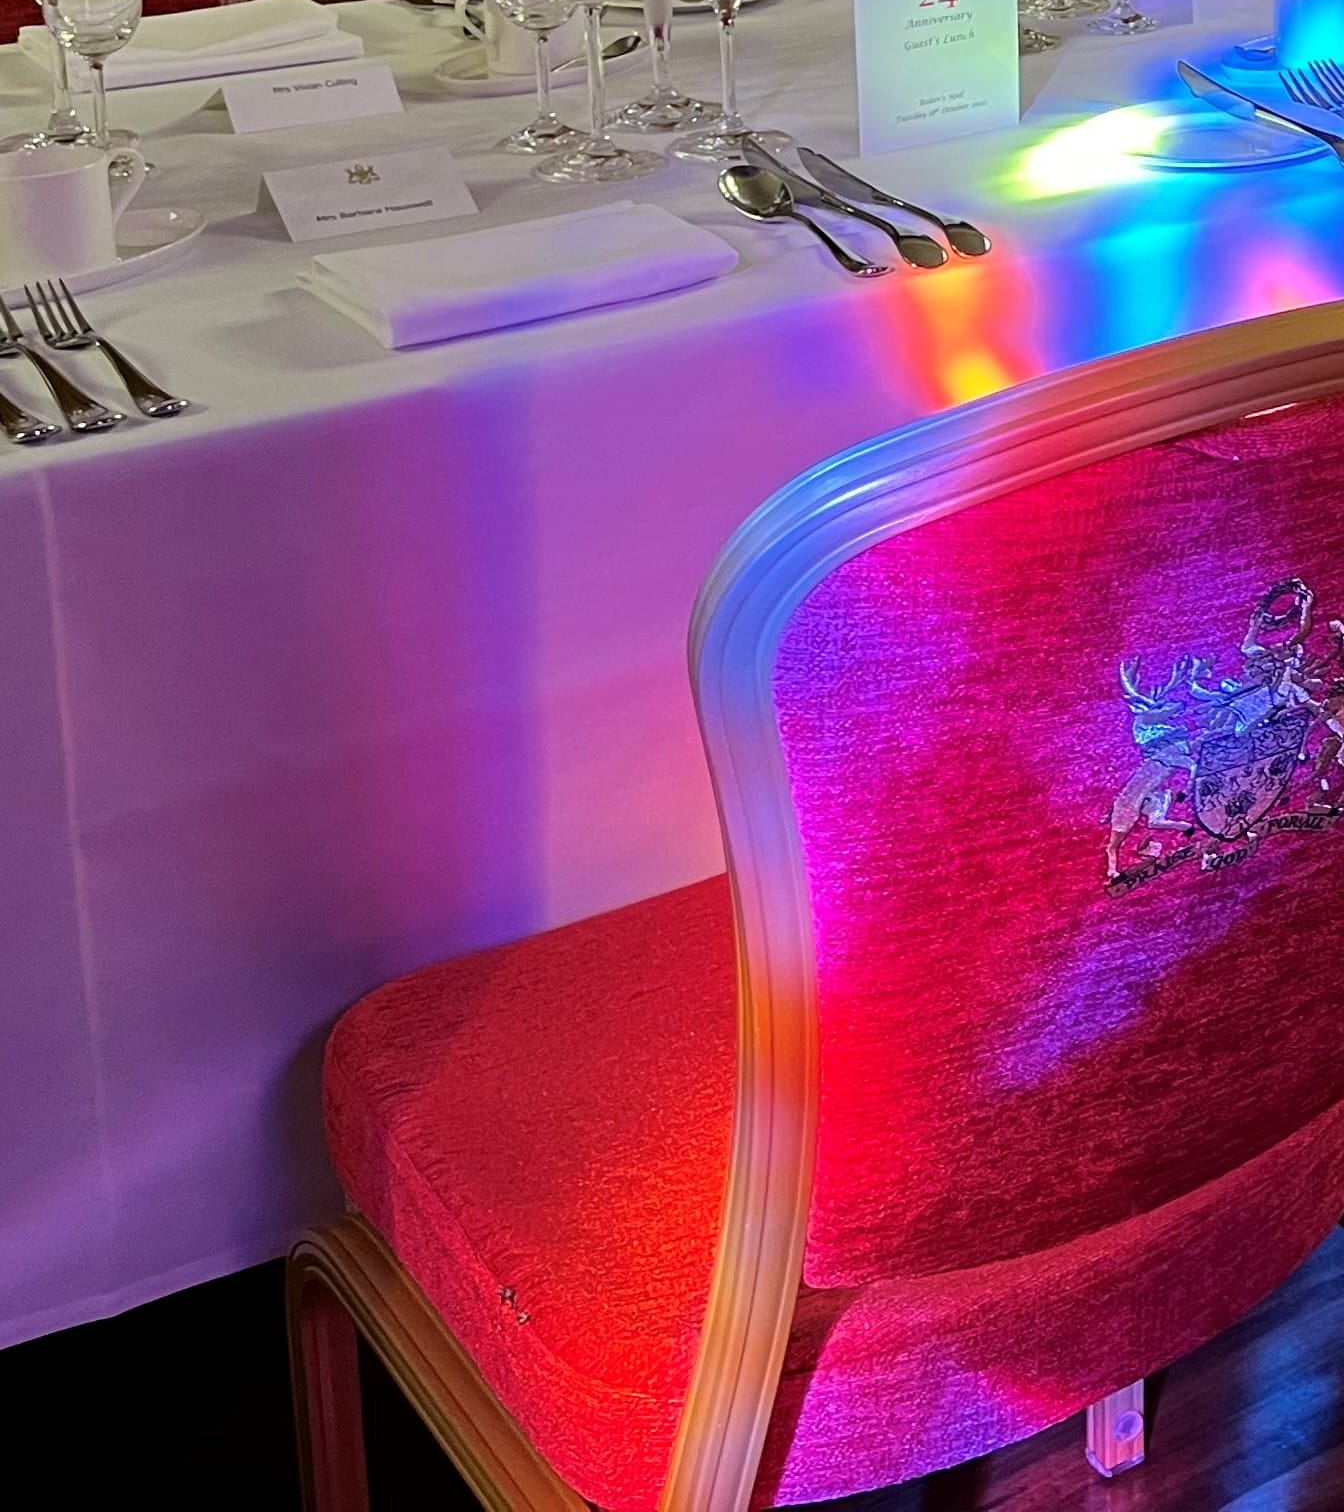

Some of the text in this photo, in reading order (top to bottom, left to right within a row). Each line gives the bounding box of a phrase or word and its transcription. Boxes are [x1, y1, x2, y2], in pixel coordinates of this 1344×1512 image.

[904, 10, 973, 30] Anniversary
[943, 28, 975, 44] Lunch
[1209, 848, 1248, 869] GOD
[1268, 816, 1298, 833] FOR
